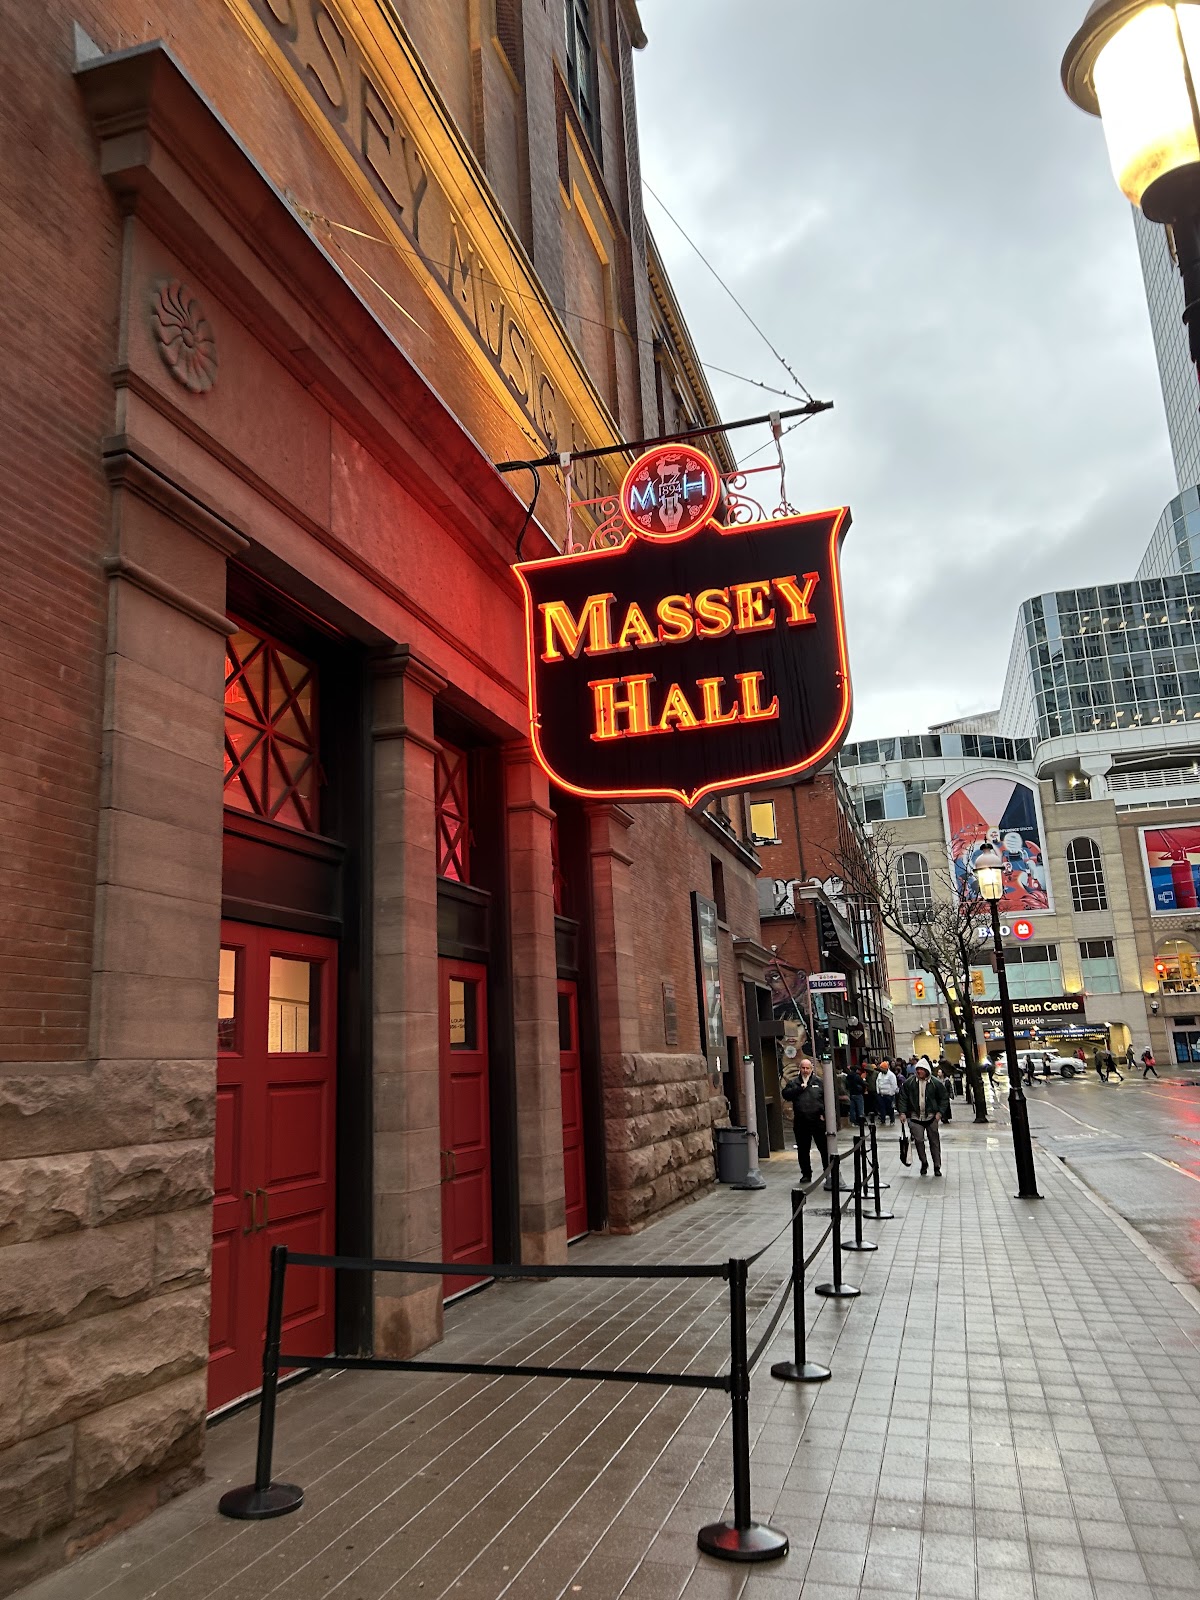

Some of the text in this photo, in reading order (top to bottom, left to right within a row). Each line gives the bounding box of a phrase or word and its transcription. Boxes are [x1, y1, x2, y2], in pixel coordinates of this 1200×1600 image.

[448, 211, 559, 450] MUSIC
[630, 480, 657, 511] M
[682, 470, 706, 500] H
[537, 571, 820, 663] MASSEY
[587, 671, 780, 741] HALL
[818, 980, 837, 988] Enoch's
[972, 1005, 1002, 1015] Toron
[1013, 1003, 1042, 1013] Eaton
[1043, 1001, 1080, 1012] Centre
[989, 1018, 1045, 1027] Yon Parkade
